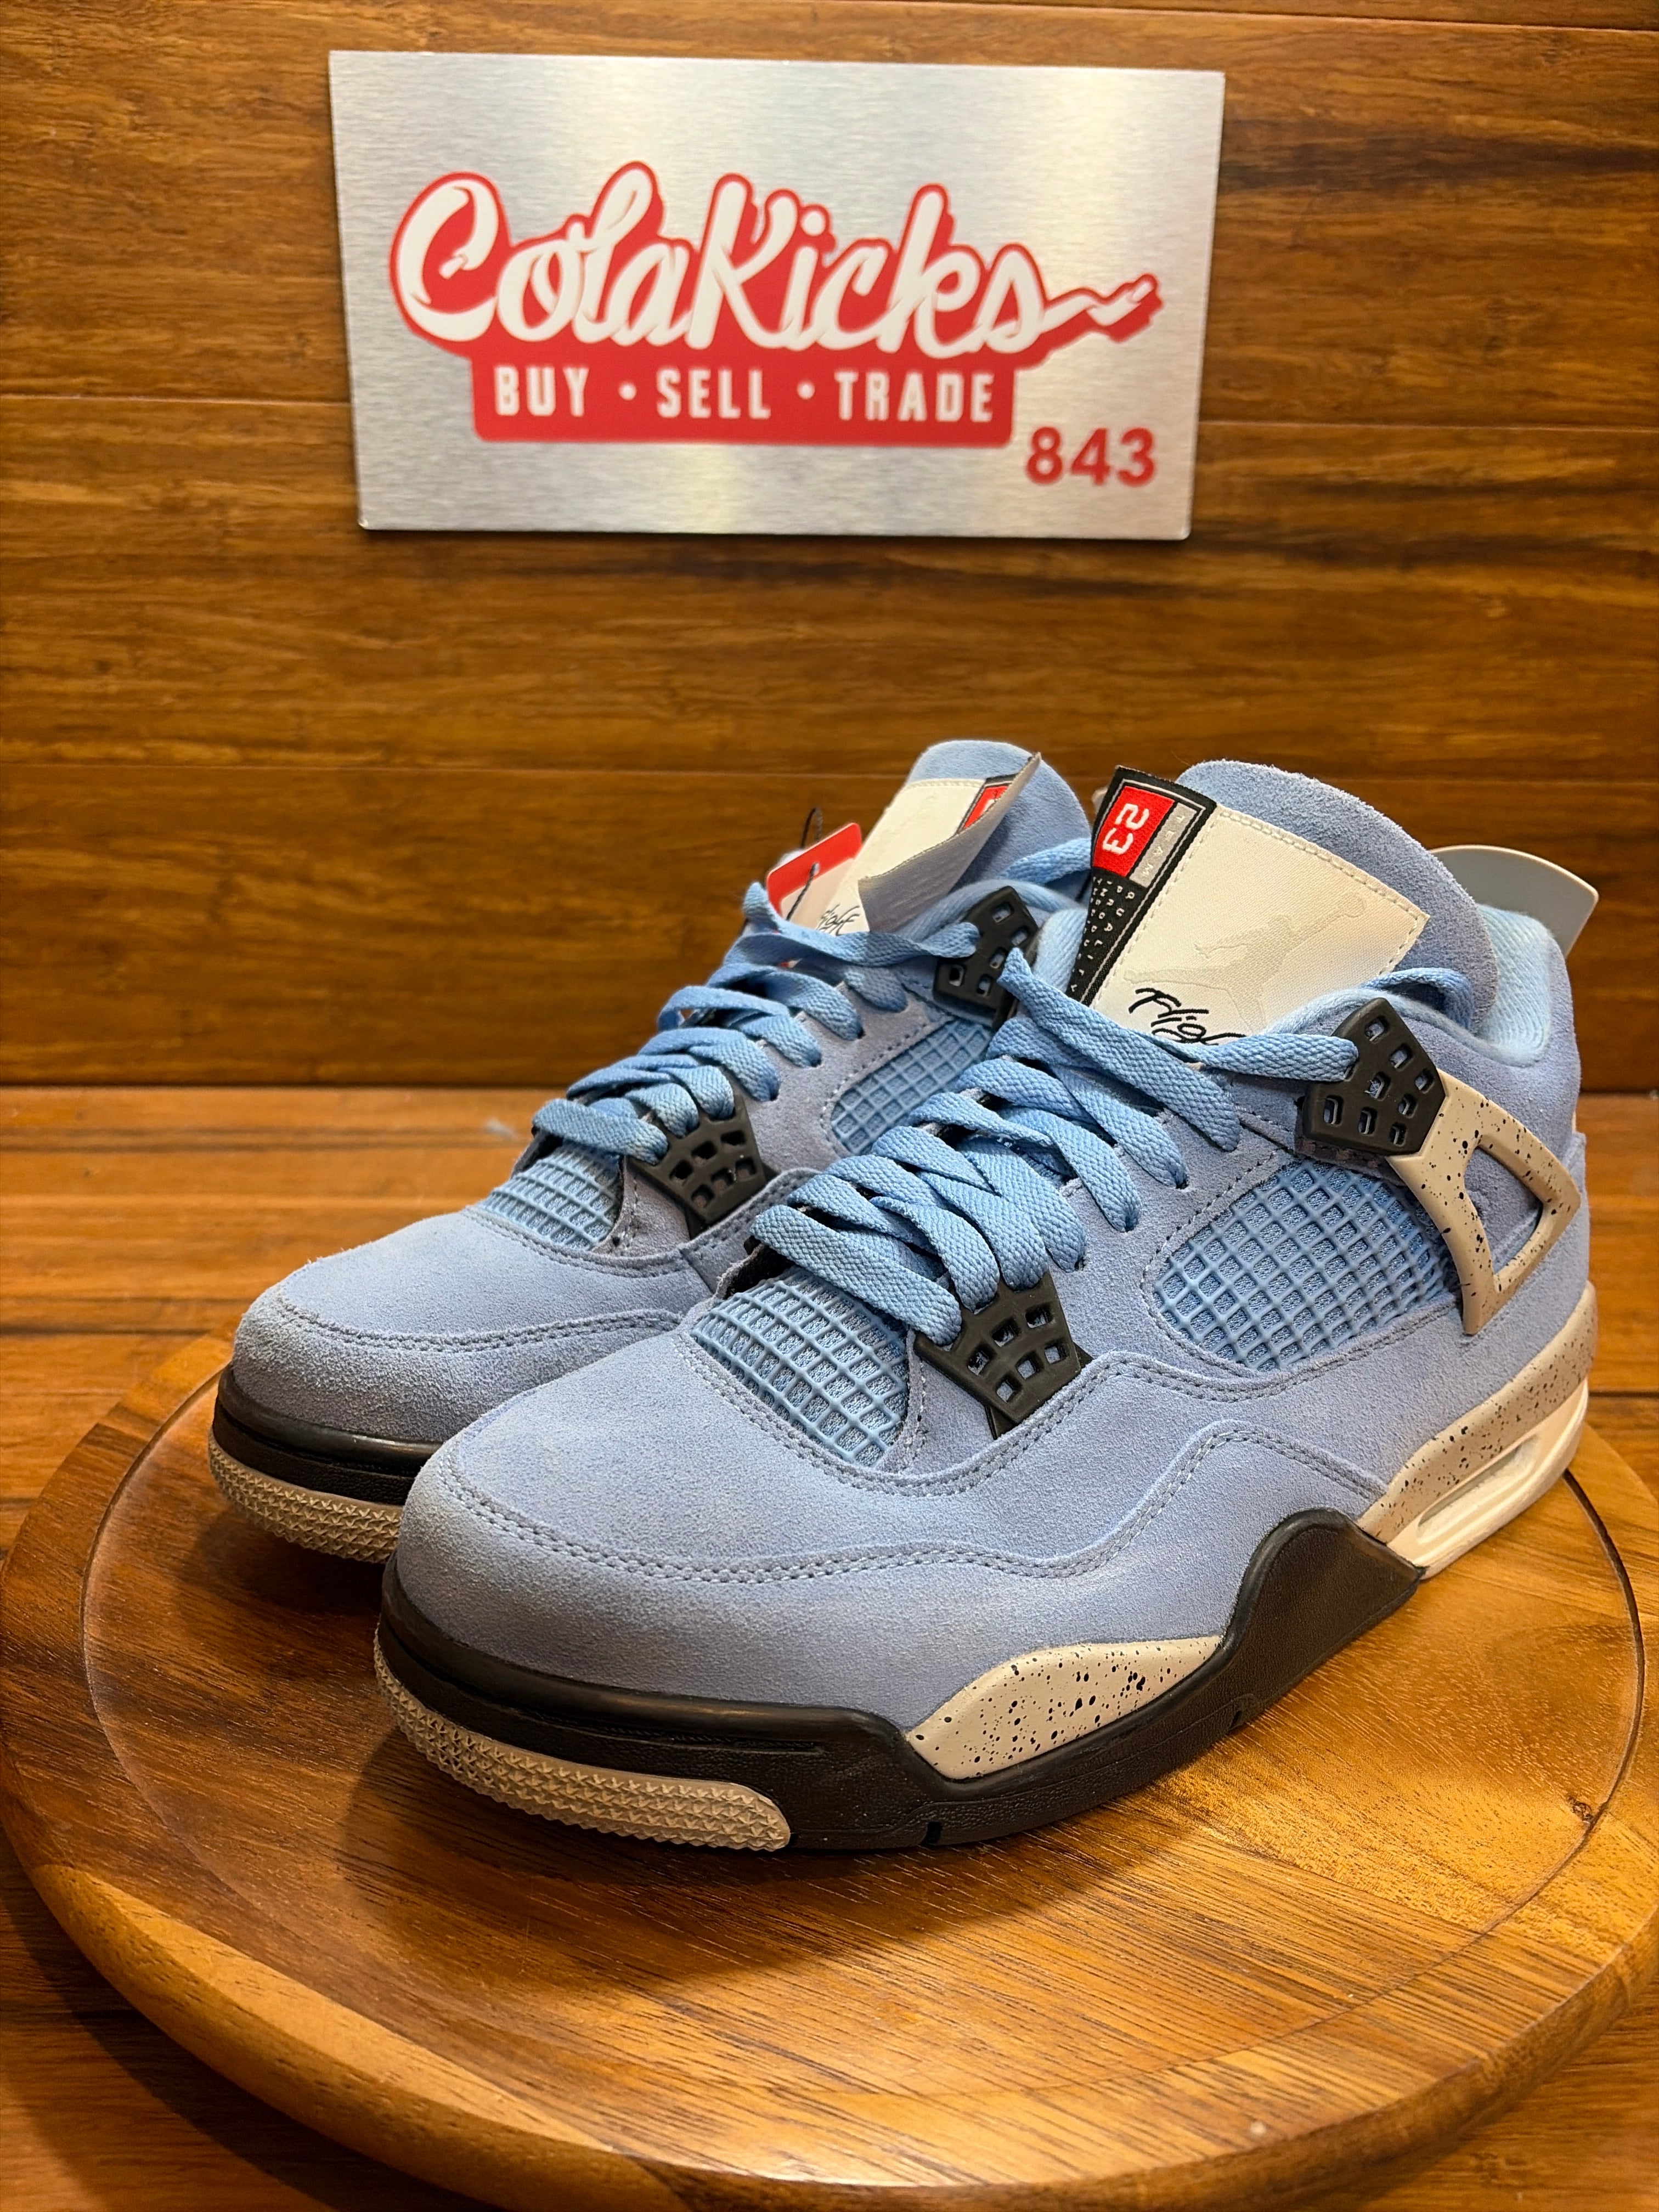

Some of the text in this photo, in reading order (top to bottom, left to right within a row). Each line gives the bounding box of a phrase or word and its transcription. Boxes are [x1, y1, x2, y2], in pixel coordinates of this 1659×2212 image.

[393, 165, 1155, 359] ColaKicks
[494, 365, 995, 422] BUY SELL TRADE
[1026, 426, 1155, 487] 843
[1102, 803, 1150, 855] 23
[1142, 815, 1186, 876] TEAM
[1070, 891, 1135, 992] QUALITY
[1128, 988, 1247, 1046] Flig
